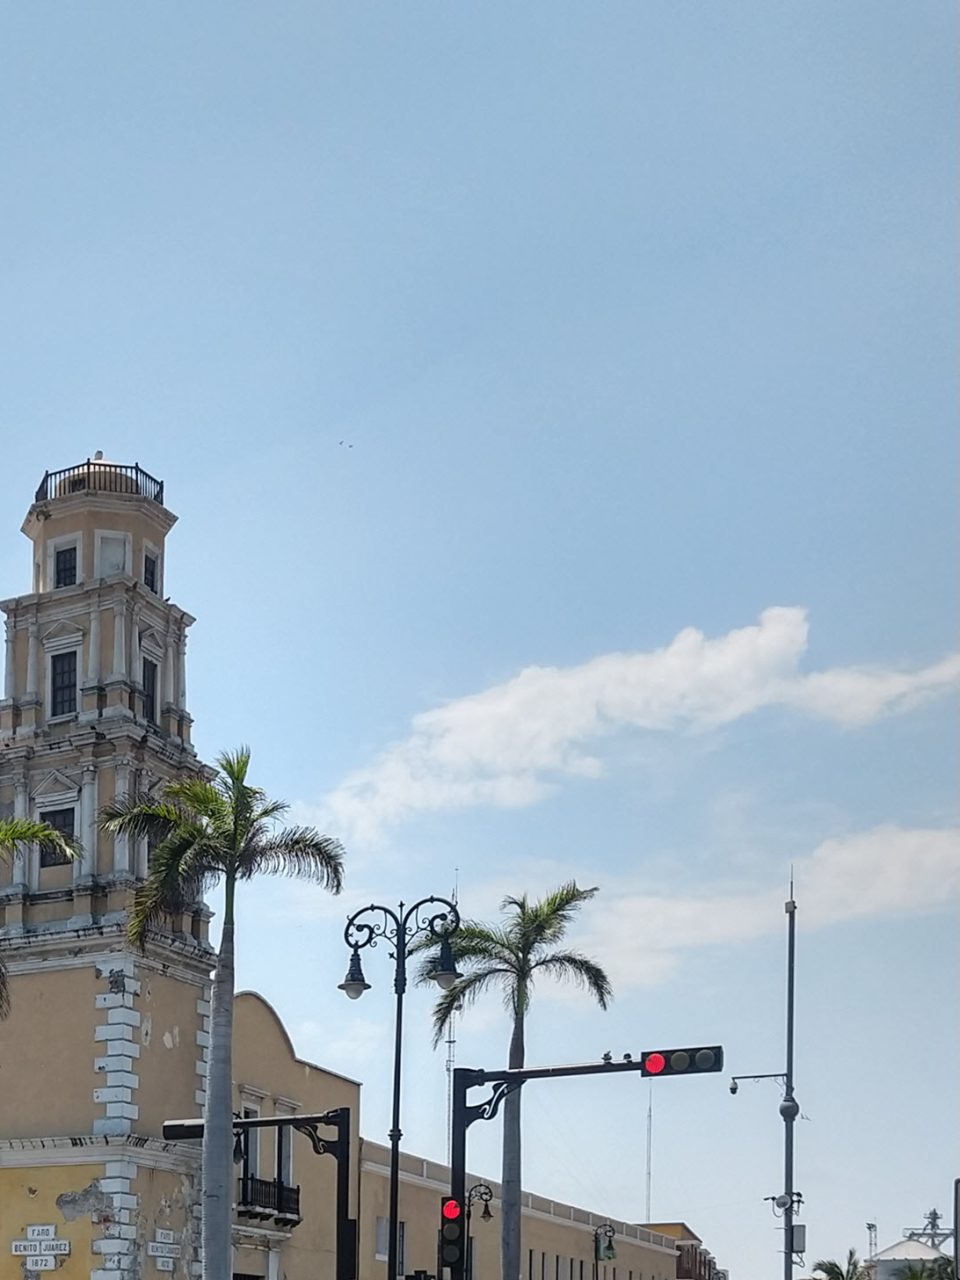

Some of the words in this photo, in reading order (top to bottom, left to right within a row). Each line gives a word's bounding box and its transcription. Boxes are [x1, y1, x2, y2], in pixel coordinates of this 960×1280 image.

[31, 1228, 50, 1237] FARO
[14, 1243, 38, 1253] BENITO
[42, 1242, 68, 1252] JUAREZ
[31, 1258, 49, 1267] 1872
